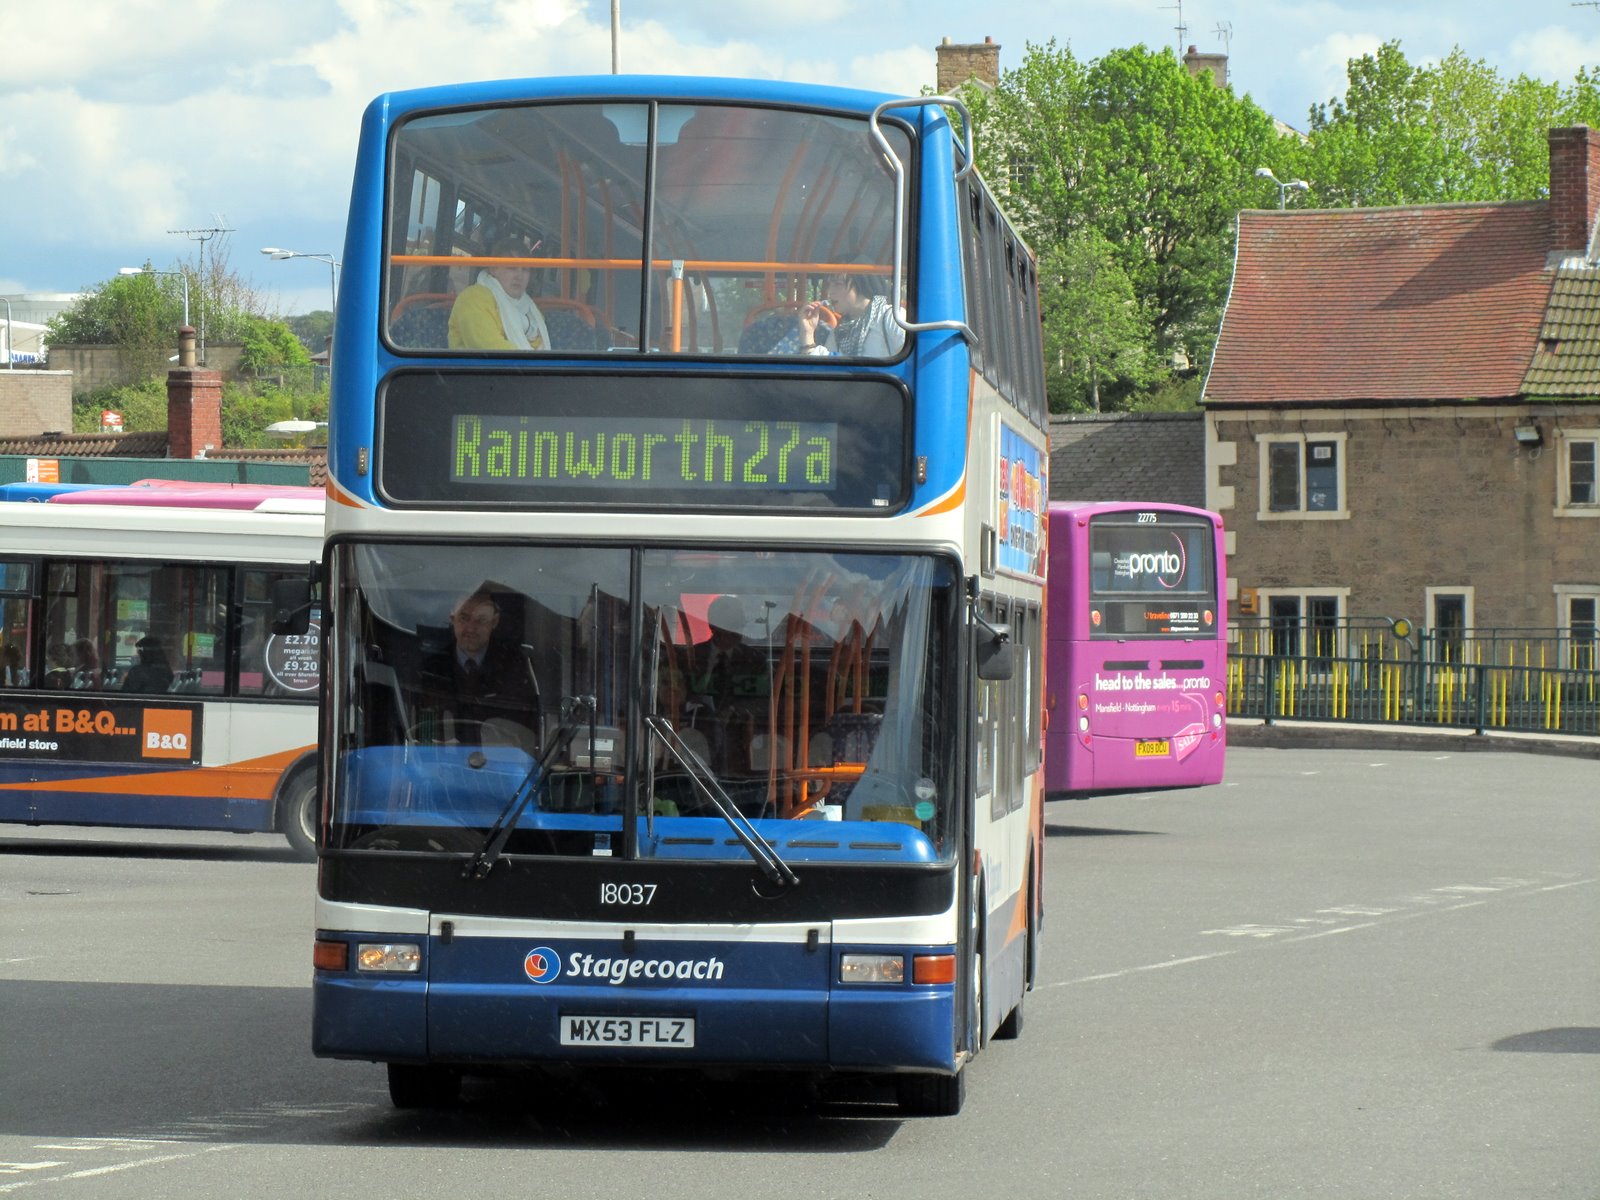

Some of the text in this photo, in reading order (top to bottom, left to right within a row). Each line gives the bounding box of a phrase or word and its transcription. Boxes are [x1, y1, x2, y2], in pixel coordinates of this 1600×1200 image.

[455, 414, 831, 485] Rainworth 27a
[1137, 513, 1157, 523] 22775
[1129, 550, 1180, 579] pronto
[285, 635, 318, 645] £2.70
[284, 661, 317, 671] £9.20
[1095, 672, 1121, 691] head
[1122, 675, 1133, 690] to
[1134, 671, 1152, 690] the
[1183, 676, 1210, 692] pronto
[1125, 702, 1156, 715] Nottingham
[1171, 700, 1180, 713] 15
[23, 709, 50, 732] at
[55, 709, 137, 736] B&Q...
[29, 739, 58, 751] store
[147, 732, 187, 750] B&Q
[1178, 730, 1197, 752] SALE
[601, 883, 658, 905] 18037
[566, 952, 724, 985] Stagecoach
[570, 1019, 686, 1043] MX53 FLZ
